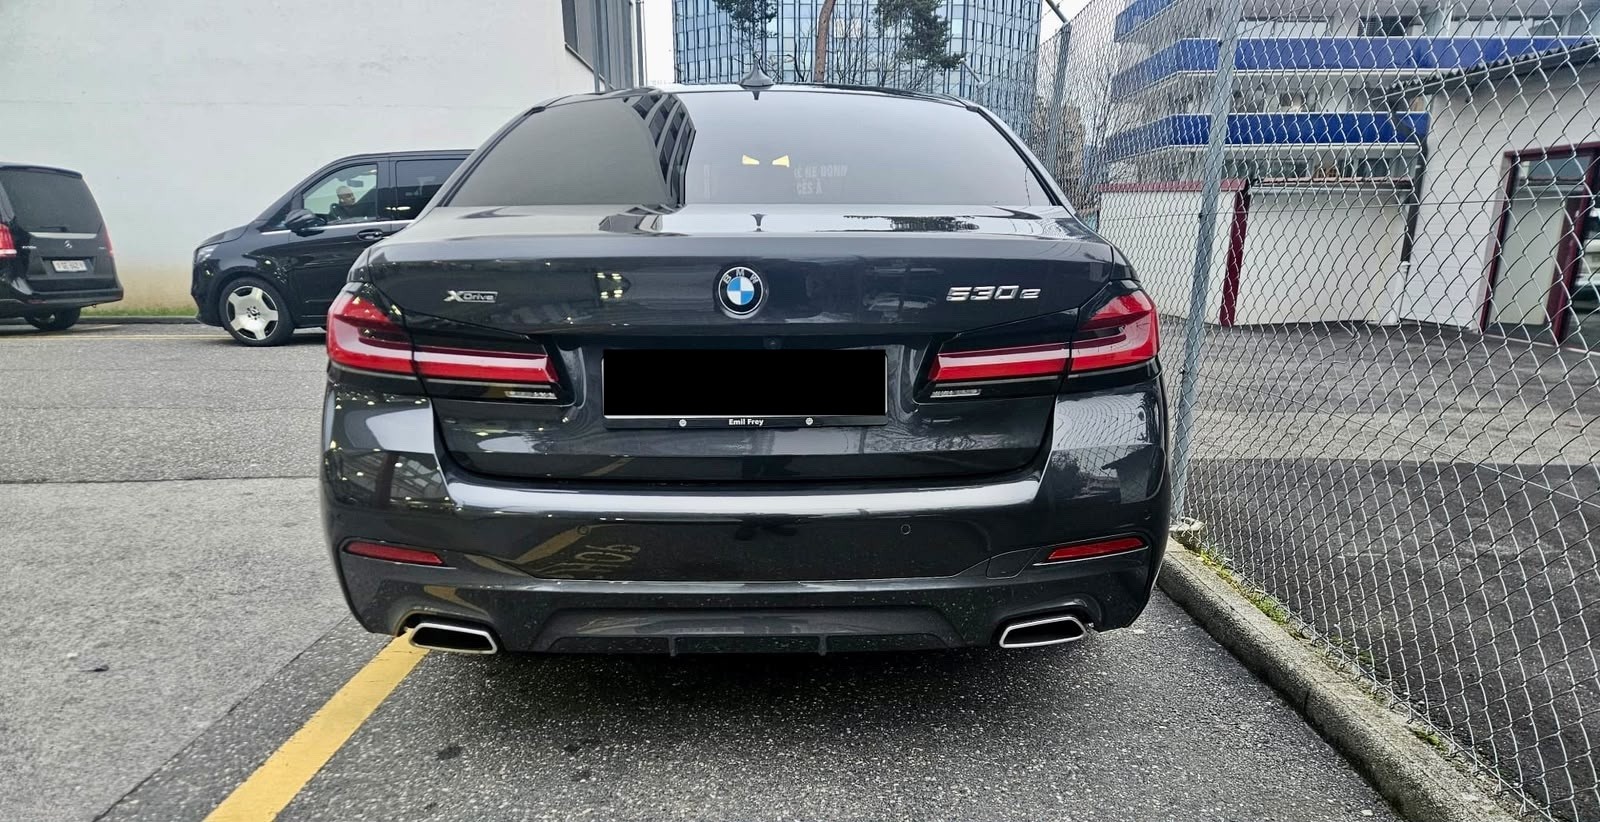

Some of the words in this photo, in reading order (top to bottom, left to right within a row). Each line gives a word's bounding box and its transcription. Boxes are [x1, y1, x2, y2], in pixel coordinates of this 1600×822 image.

[722, 268, 760, 285] BMW
[946, 285, 1041, 301] 530e
[728, 418, 746, 426] Emil
[747, 418, 764, 427] Frey
